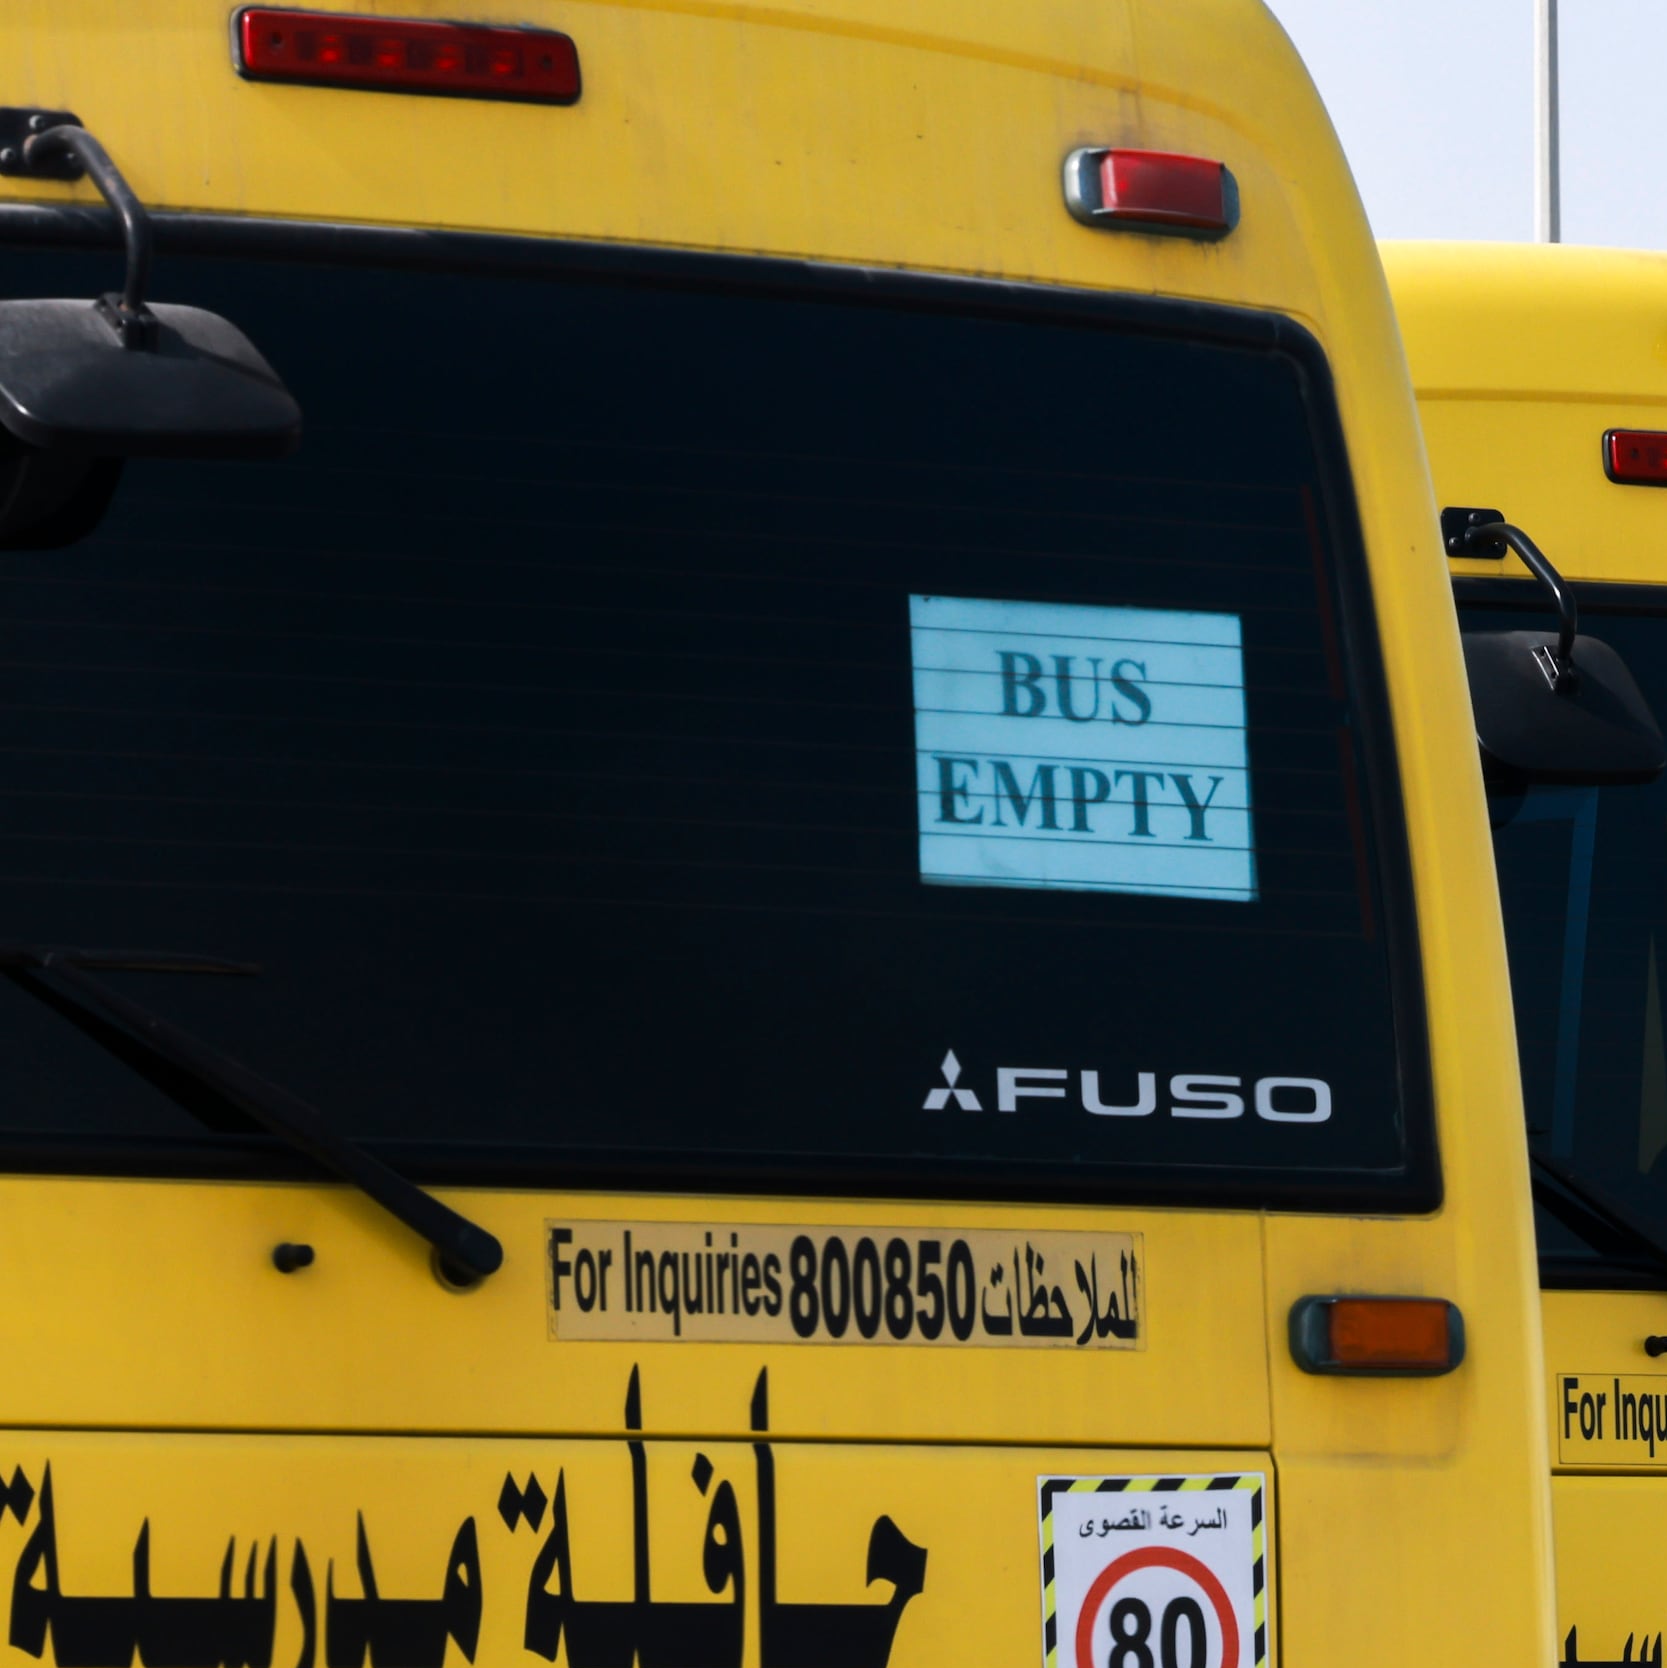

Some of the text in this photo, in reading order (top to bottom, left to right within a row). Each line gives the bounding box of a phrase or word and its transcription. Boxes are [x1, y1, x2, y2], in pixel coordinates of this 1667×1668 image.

[994, 650, 1152, 727] BUS
[932, 756, 1224, 842] EMPTY
[996, 1067, 1332, 1123] FUSO
[550, 1228, 1138, 1346] For Inquiries 800850 للملاحظات
[1563, 1377, 1606, 1441] For
[1079, 1505, 1227, 1537] السرعة القصوى
